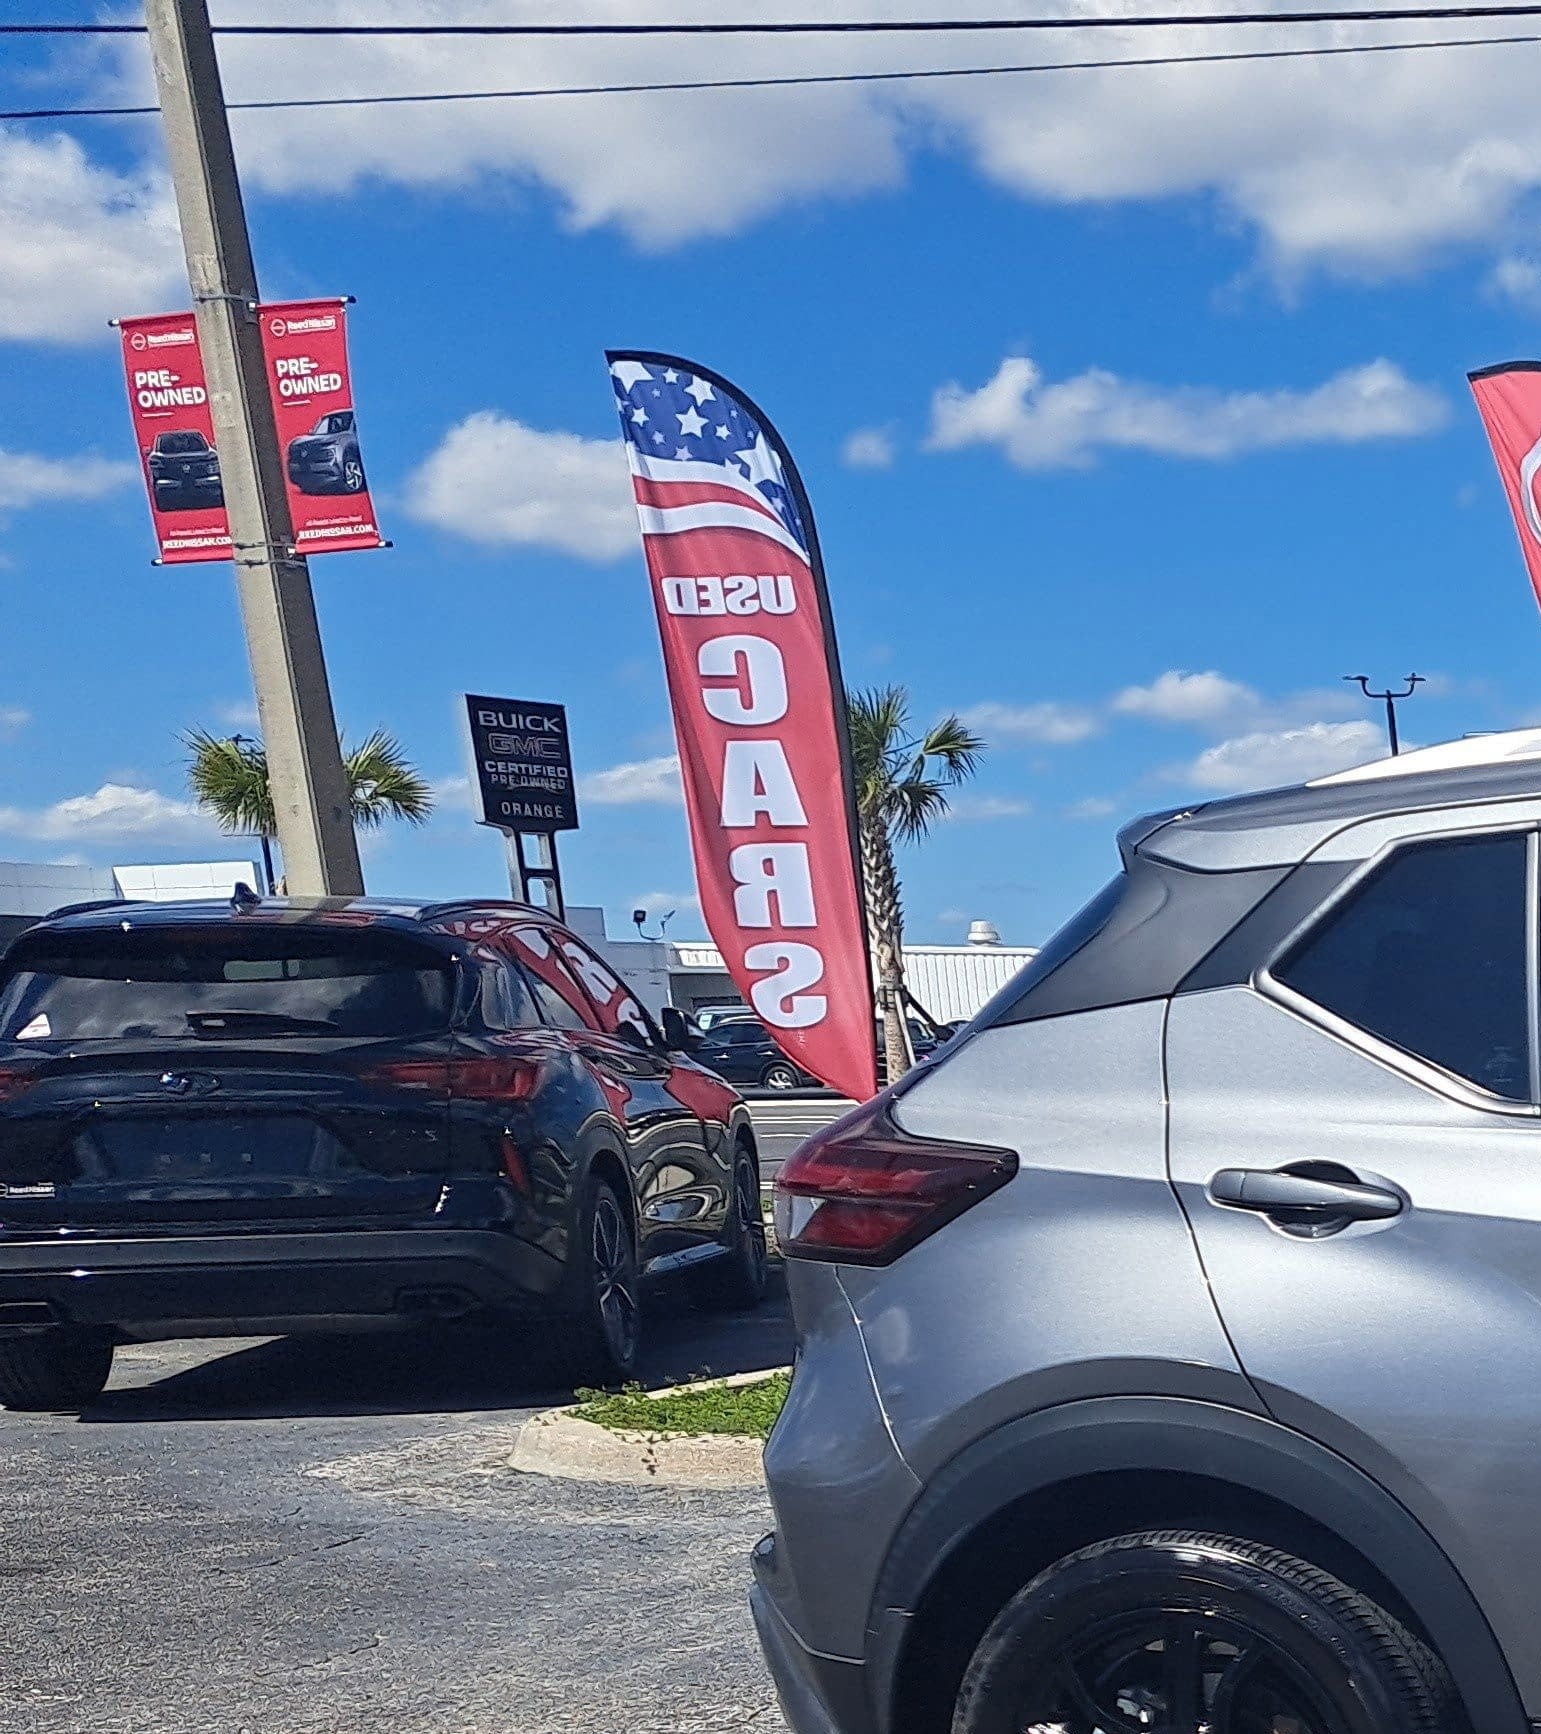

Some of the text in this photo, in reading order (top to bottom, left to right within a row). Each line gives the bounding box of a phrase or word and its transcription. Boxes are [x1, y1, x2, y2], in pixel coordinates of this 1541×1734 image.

[276, 357, 319, 377] PRE-
[135, 369, 180, 388] PRE-
[279, 374, 342, 396] OWNED
[138, 387, 206, 408] OWNED
[478, 710, 561, 733] BUICK
[488, 732, 561, 759] GMC
[484, 760, 568, 778] CERTIFIED
[501, 801, 565, 819] ORANGE
